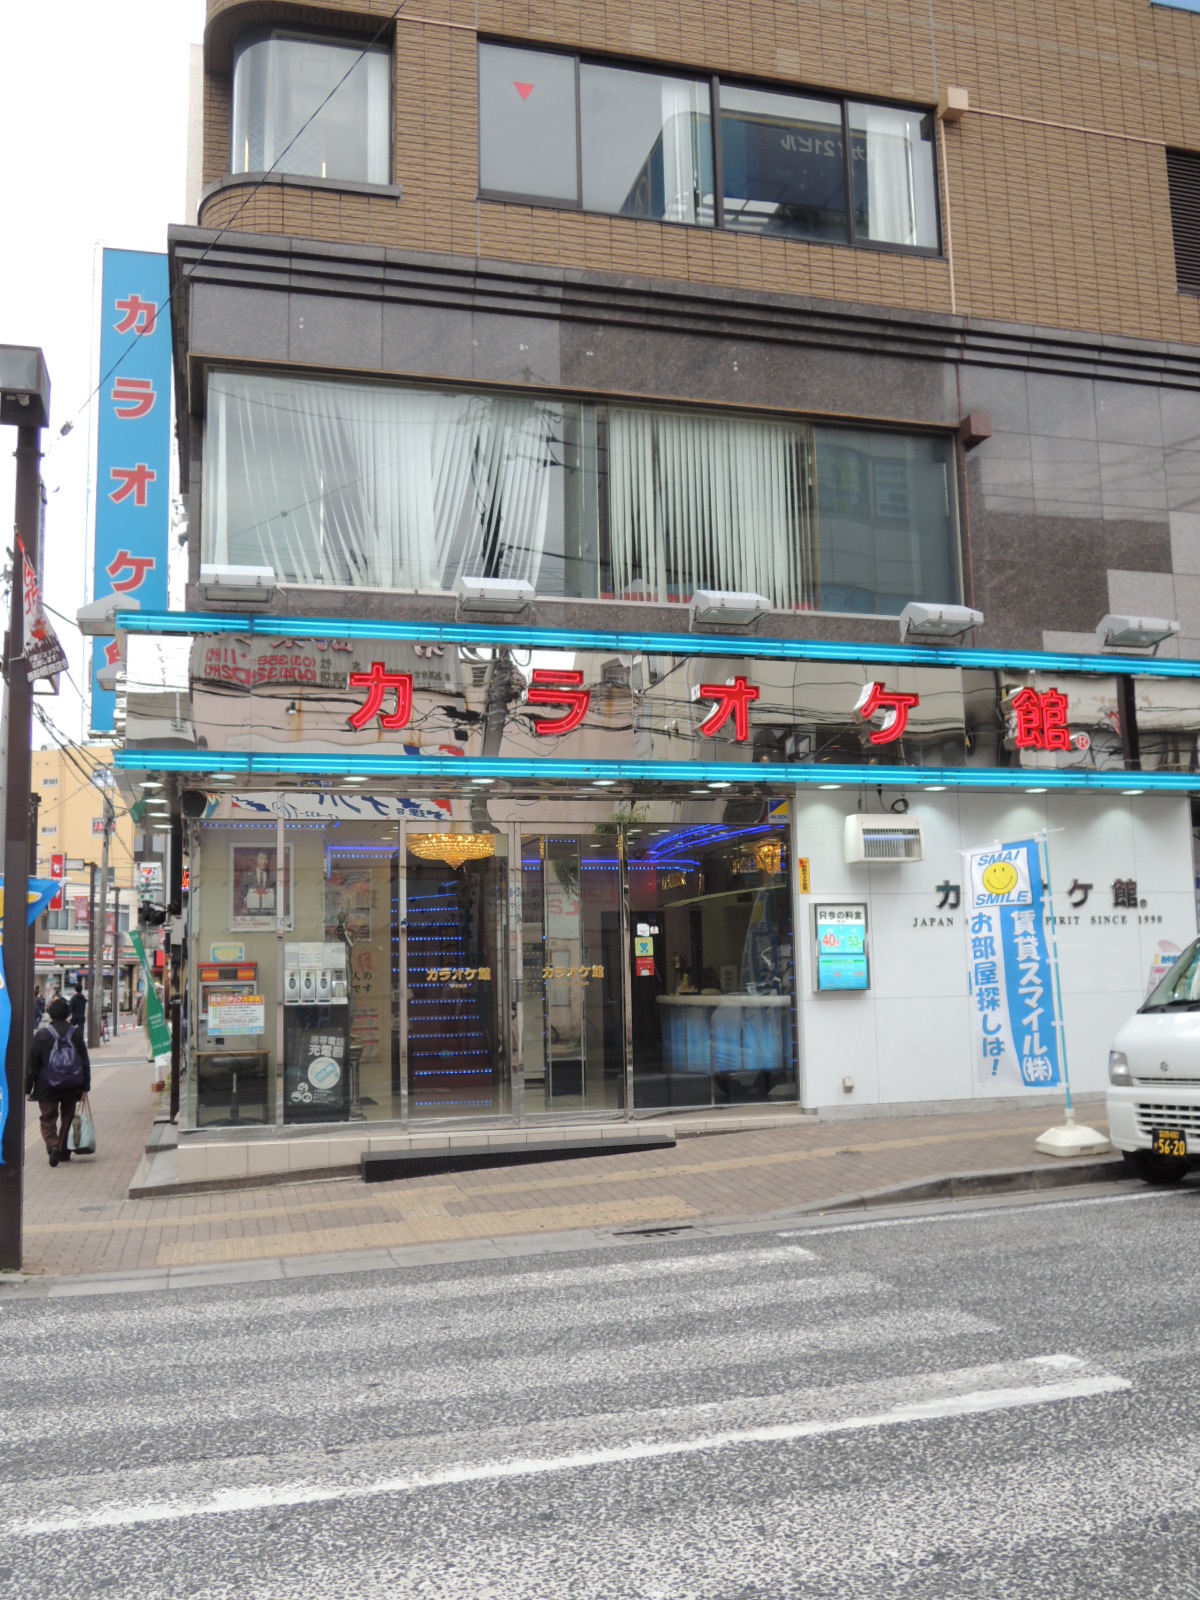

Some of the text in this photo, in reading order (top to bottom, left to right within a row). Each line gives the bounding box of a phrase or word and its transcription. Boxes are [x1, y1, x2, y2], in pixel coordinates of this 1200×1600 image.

[103, 293, 158, 666] カラオケ
[978, 850, 1020, 867] SMAI
[976, 891, 1028, 906] SMILE
[819, 911, 862, 920] 只今の料金
[913, 917, 954, 927] JAPAN
[1090, 915, 1127, 925] SINCE
[1138, 915, 1163, 924] 1990
[426, 965, 605, 981] カラオケ館 カラオケ館
[971, 912, 1005, 1076] お部屋探しは!
[310, 1035, 345, 1047] 携帯電話
[309, 1044, 344, 1059] 充電器
[1158, 1138, 1186, 1156] 56-20
